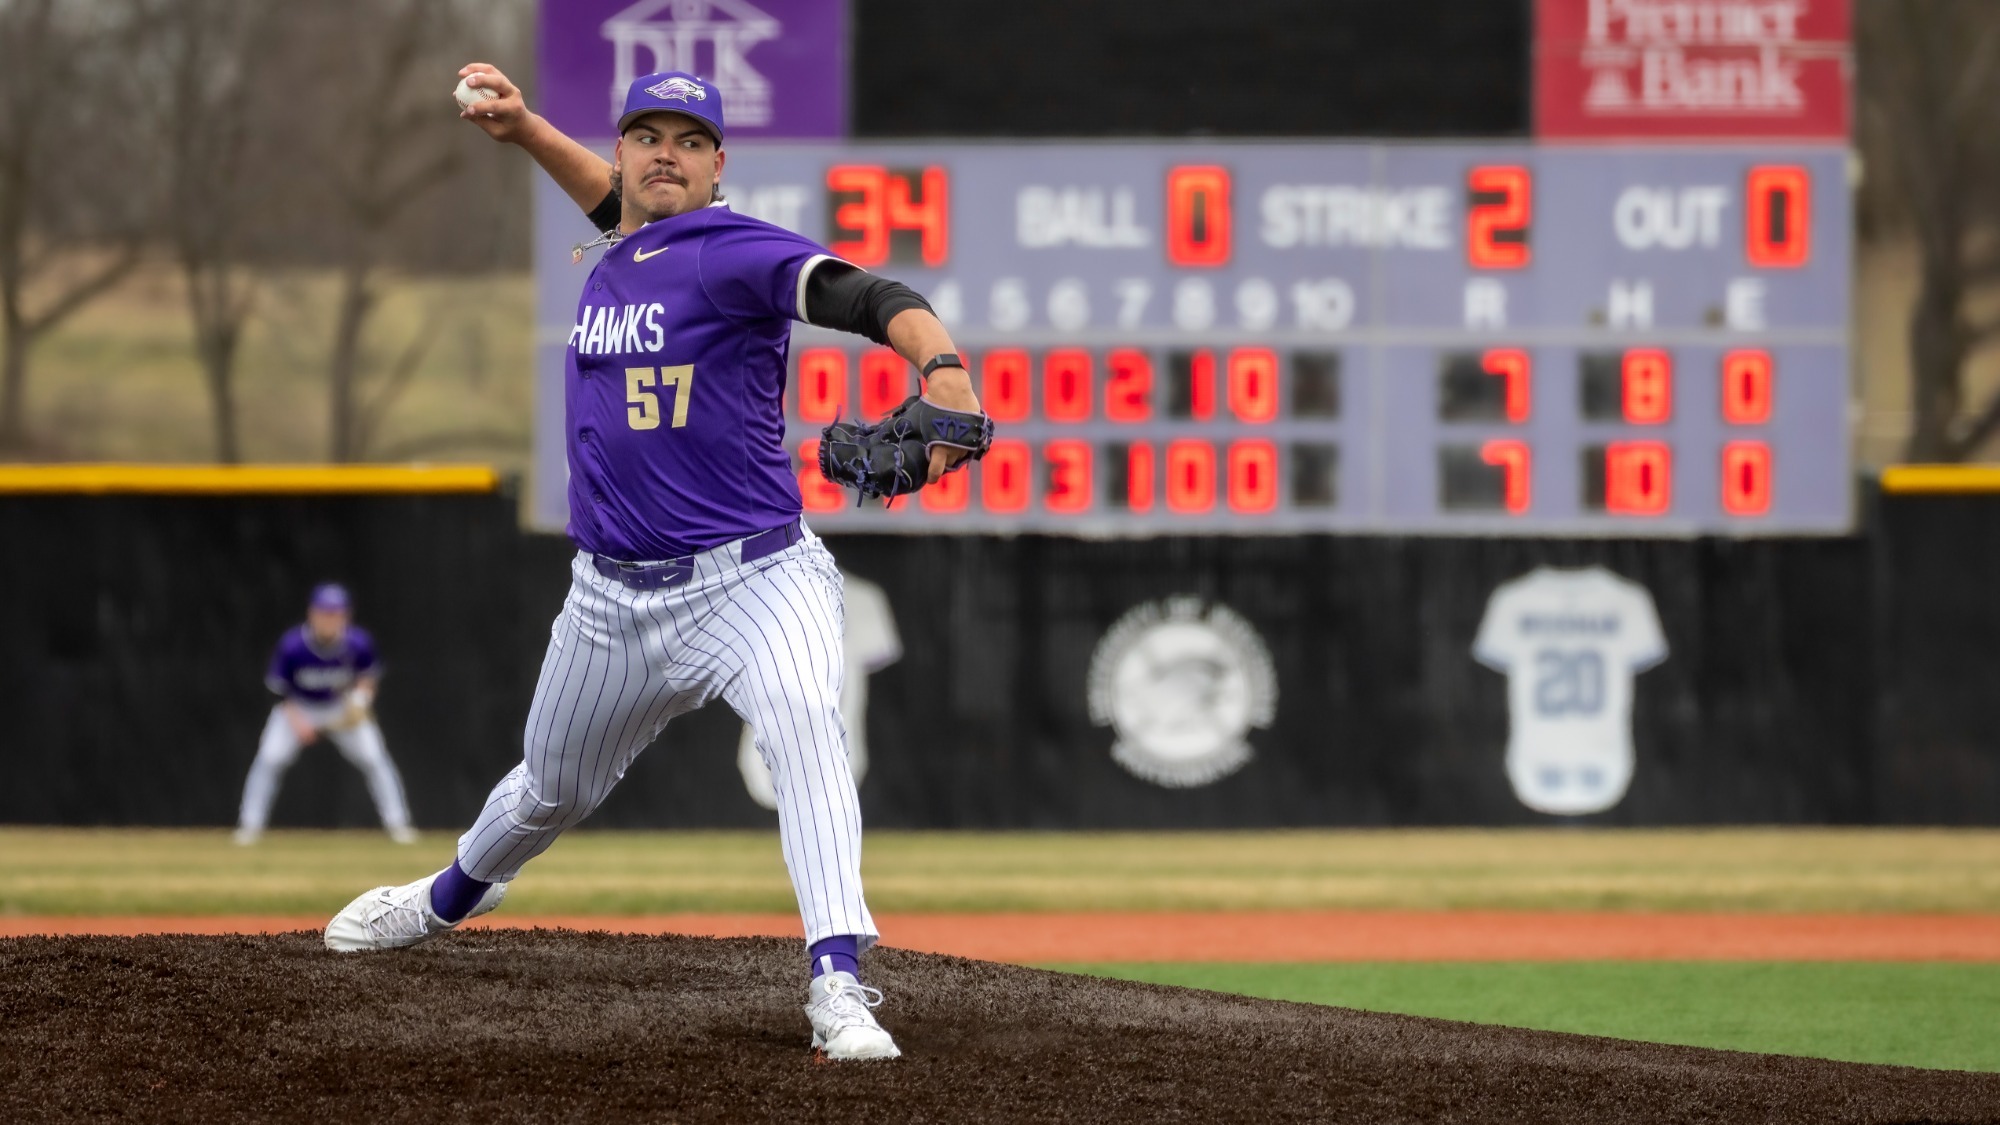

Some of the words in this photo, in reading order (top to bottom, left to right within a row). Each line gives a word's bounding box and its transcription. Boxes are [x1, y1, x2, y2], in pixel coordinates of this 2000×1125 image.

[1641, 44, 1805, 112] Bank
[826, 164, 949, 268] 34
[1016, 185, 1150, 249] BALL
[1165, 164, 1233, 268] 0
[1261, 185, 1452, 250] STRIKE
[1466, 164, 1533, 270] 2
[1613, 185, 1728, 250] OUT
[1744, 164, 1811, 269] 0
[990, 277, 1030, 333] 5
[1047, 278, 1089, 334] 6
[1116, 277, 1152, 333] 7
[1173, 278, 1215, 334] 8
[1235, 278, 1279, 333] 9
[1292, 279, 1354, 333] 10
[1463, 278, 1508, 332] R
[1607, 279, 1654, 332] H
[1726, 277, 1765, 333] E
[625, 364, 694, 430] 57
[798, 346, 849, 425] 0
[980, 346, 1033, 425] 0
[1041, 346, 1094, 425] 0
[1103, 346, 1155, 425] 2
[1226, 346, 1280, 425] 0
[1481, 347, 1531, 424] 7
[1620, 346, 1673, 426] 8
[1722, 347, 1774, 426] 0
[981, 437, 1034, 516] 0
[1042, 437, 1094, 516] 3
[1165, 437, 1219, 515] 0
[1225, 437, 1280, 515] 0
[1480, 438, 1531, 516] 7
[1605, 438, 1673, 517] 10
[1721, 438, 1774, 518] 0
[1534, 648, 1606, 718] 20
